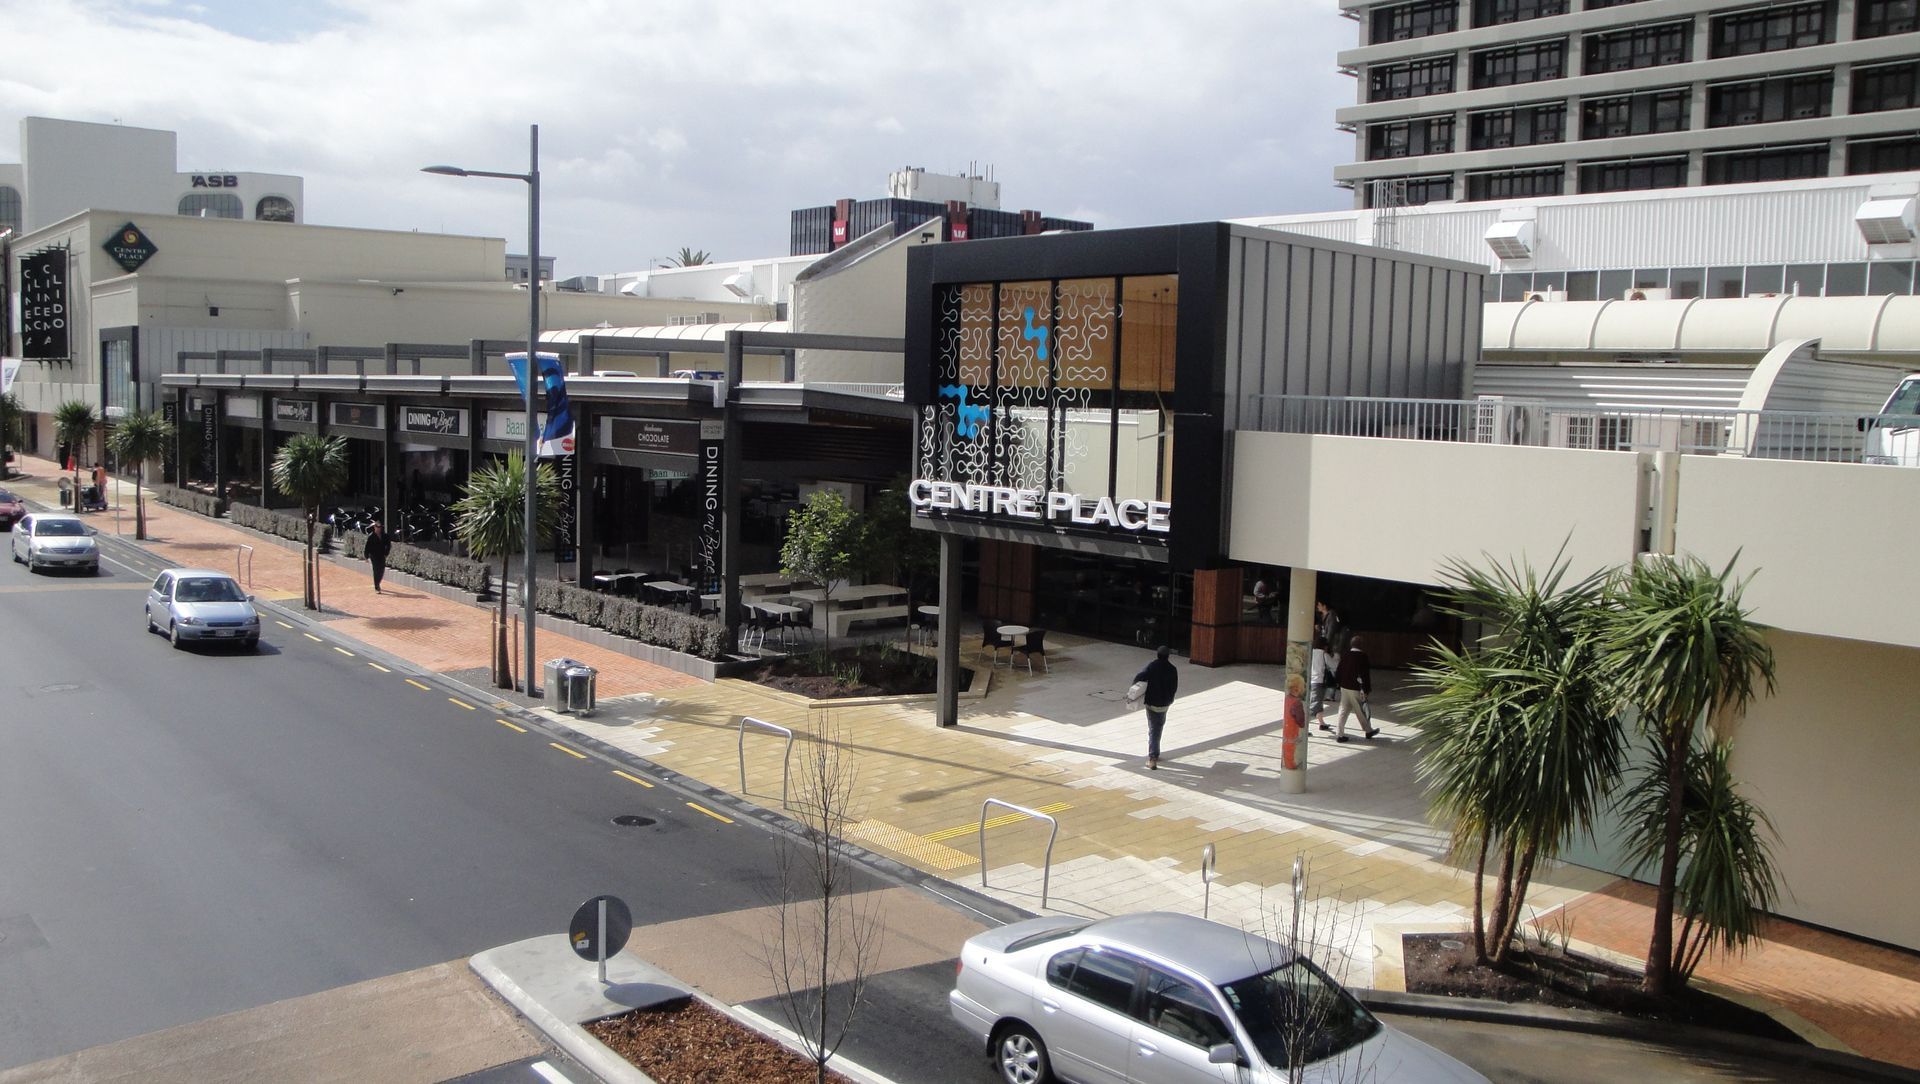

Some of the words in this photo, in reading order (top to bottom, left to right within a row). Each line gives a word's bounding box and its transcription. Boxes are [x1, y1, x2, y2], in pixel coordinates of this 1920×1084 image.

[192, 175, 238, 188] ASB
[52, 274, 65, 329] LIDO
[204, 407, 213, 441] DINING
[408, 412, 431, 425] DINING
[505, 417, 525, 435] Baan
[705, 446, 718, 511] DINING
[908, 479, 1041, 518] CENTRE
[1047, 491, 1171, 532] PLACE
